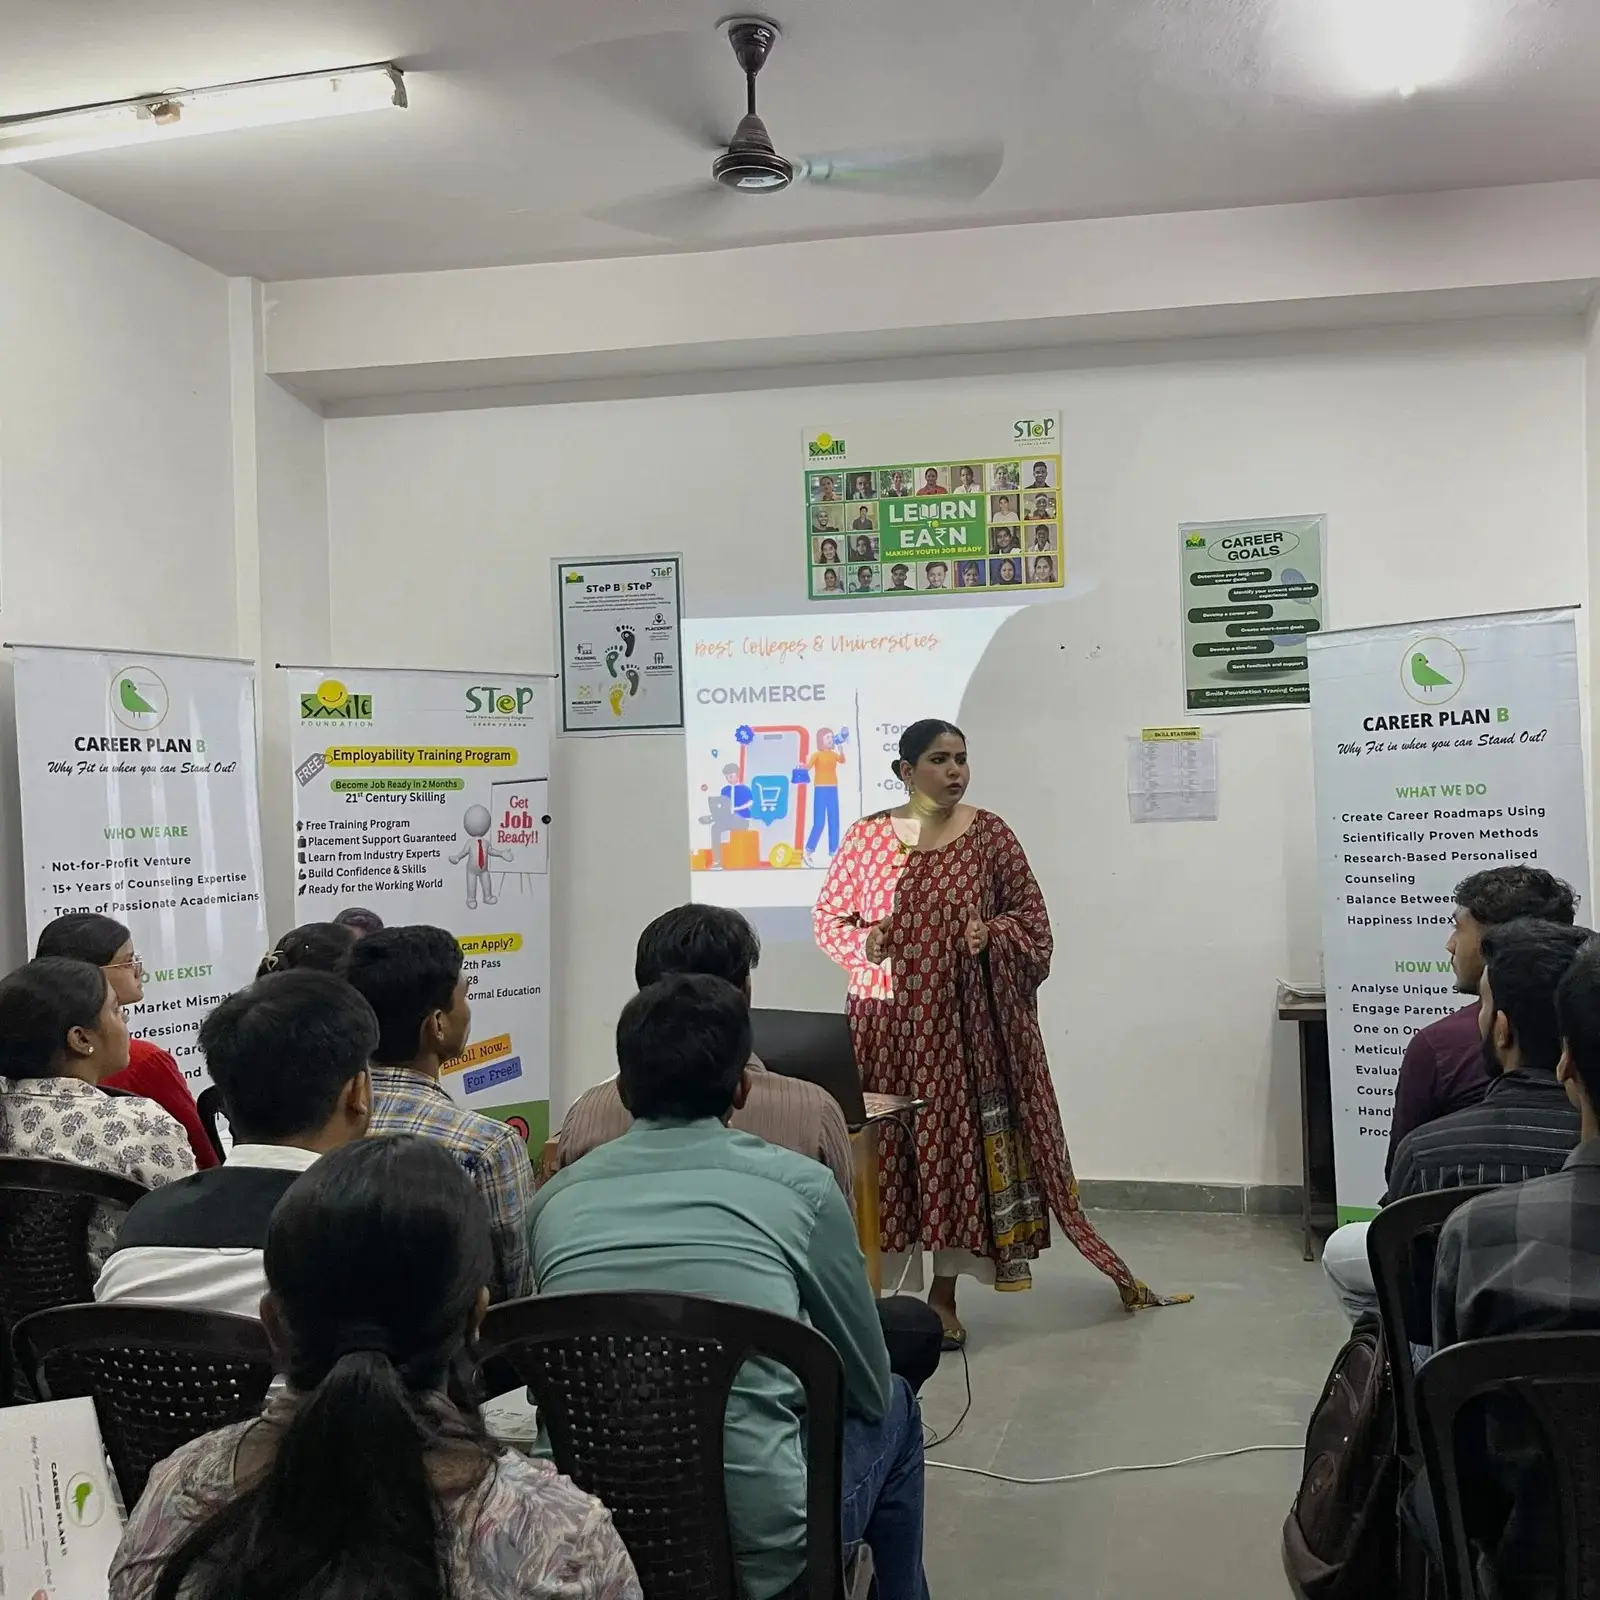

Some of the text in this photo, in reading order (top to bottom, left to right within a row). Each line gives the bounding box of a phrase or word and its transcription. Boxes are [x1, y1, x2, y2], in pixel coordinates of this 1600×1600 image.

[1221, 532, 1284, 549] CAREER
[1227, 545, 1280, 561] GOALS
[586, 582, 652, 592] STeP STeP
[695, 639, 734, 658] Best
[743, 636, 808, 663] Colleges
[832, 632, 941, 652] Universities
[697, 684, 826, 704] COMMERCE
[1363, 707, 1509, 732] CAREER PLAN B
[74, 736, 206, 753] CAREER PLAN B
[1338, 729, 1548, 757] Why Fit in when you can Stand Out?
[333, 749, 511, 763] Employability Training Program
[47, 760, 237, 776] Why Fit in when you can Stand Out?
[297, 756, 322, 784] FREE
[335, 780, 368, 789] Become
[370, 780, 385, 789] Job
[387, 779, 412, 791] Ready
[422, 780, 428, 788] 2
[428, 779, 457, 788] Months
[1396, 783, 1487, 799] WHAT WE DO
[345, 791, 446, 805] 21st Century Skilling
[509, 795, 529, 809] Get
[500, 811, 533, 829] Job
[1341, 805, 1546, 823] Create Career Roadmaps Using
[103, 825, 188, 840] WHO WE ARE
[306, 819, 410, 831] Free Training Program
[308, 833, 457, 848] Placement Support Guaranteed
[497, 830, 539, 847] Ready!!
[1343, 827, 1539, 843] Scientifically Proven Methods
[308, 848, 441, 862] Learn from Industry Experts
[1344, 849, 1538, 863] Research-Based Personalised
[52, 856, 192, 873] Not-for-Profit Venture
[308, 864, 427, 878] Build Confidence & Skills
[52, 872, 247, 894] 15+ Years of Counseling Expertise
[1345, 873, 1416, 885] Counseling
[308, 878, 443, 896] Ready for the Working World
[54, 891, 260, 916] Team of Passionate Academicians
[1346, 894, 1396, 904] Balance
[1347, 914, 1454, 926] Happiness Index
[462, 937, 514, 952] can Apply?
[462, 959, 501, 970] 2th Pass
[1395, 961, 1433, 973] HOW
[155, 964, 213, 982] WE EXIST
[466, 985, 541, 1000] ormal Education
[1351, 984, 1399, 995] Analyse
[1403, 984, 1448, 996] Unique
[134, 999, 181, 1015] Market
[1352, 1004, 1455, 1016] Engage Parents
[129, 1019, 203, 1039] rofessiona
[1353, 1024, 1399, 1034] One on
[443, 1050, 475, 1070] Enroll
[466, 1062, 519, 1089] For Free!!
[1356, 1065, 1400, 1076] Evalua
[1357, 1086, 1394, 1096] Cours
